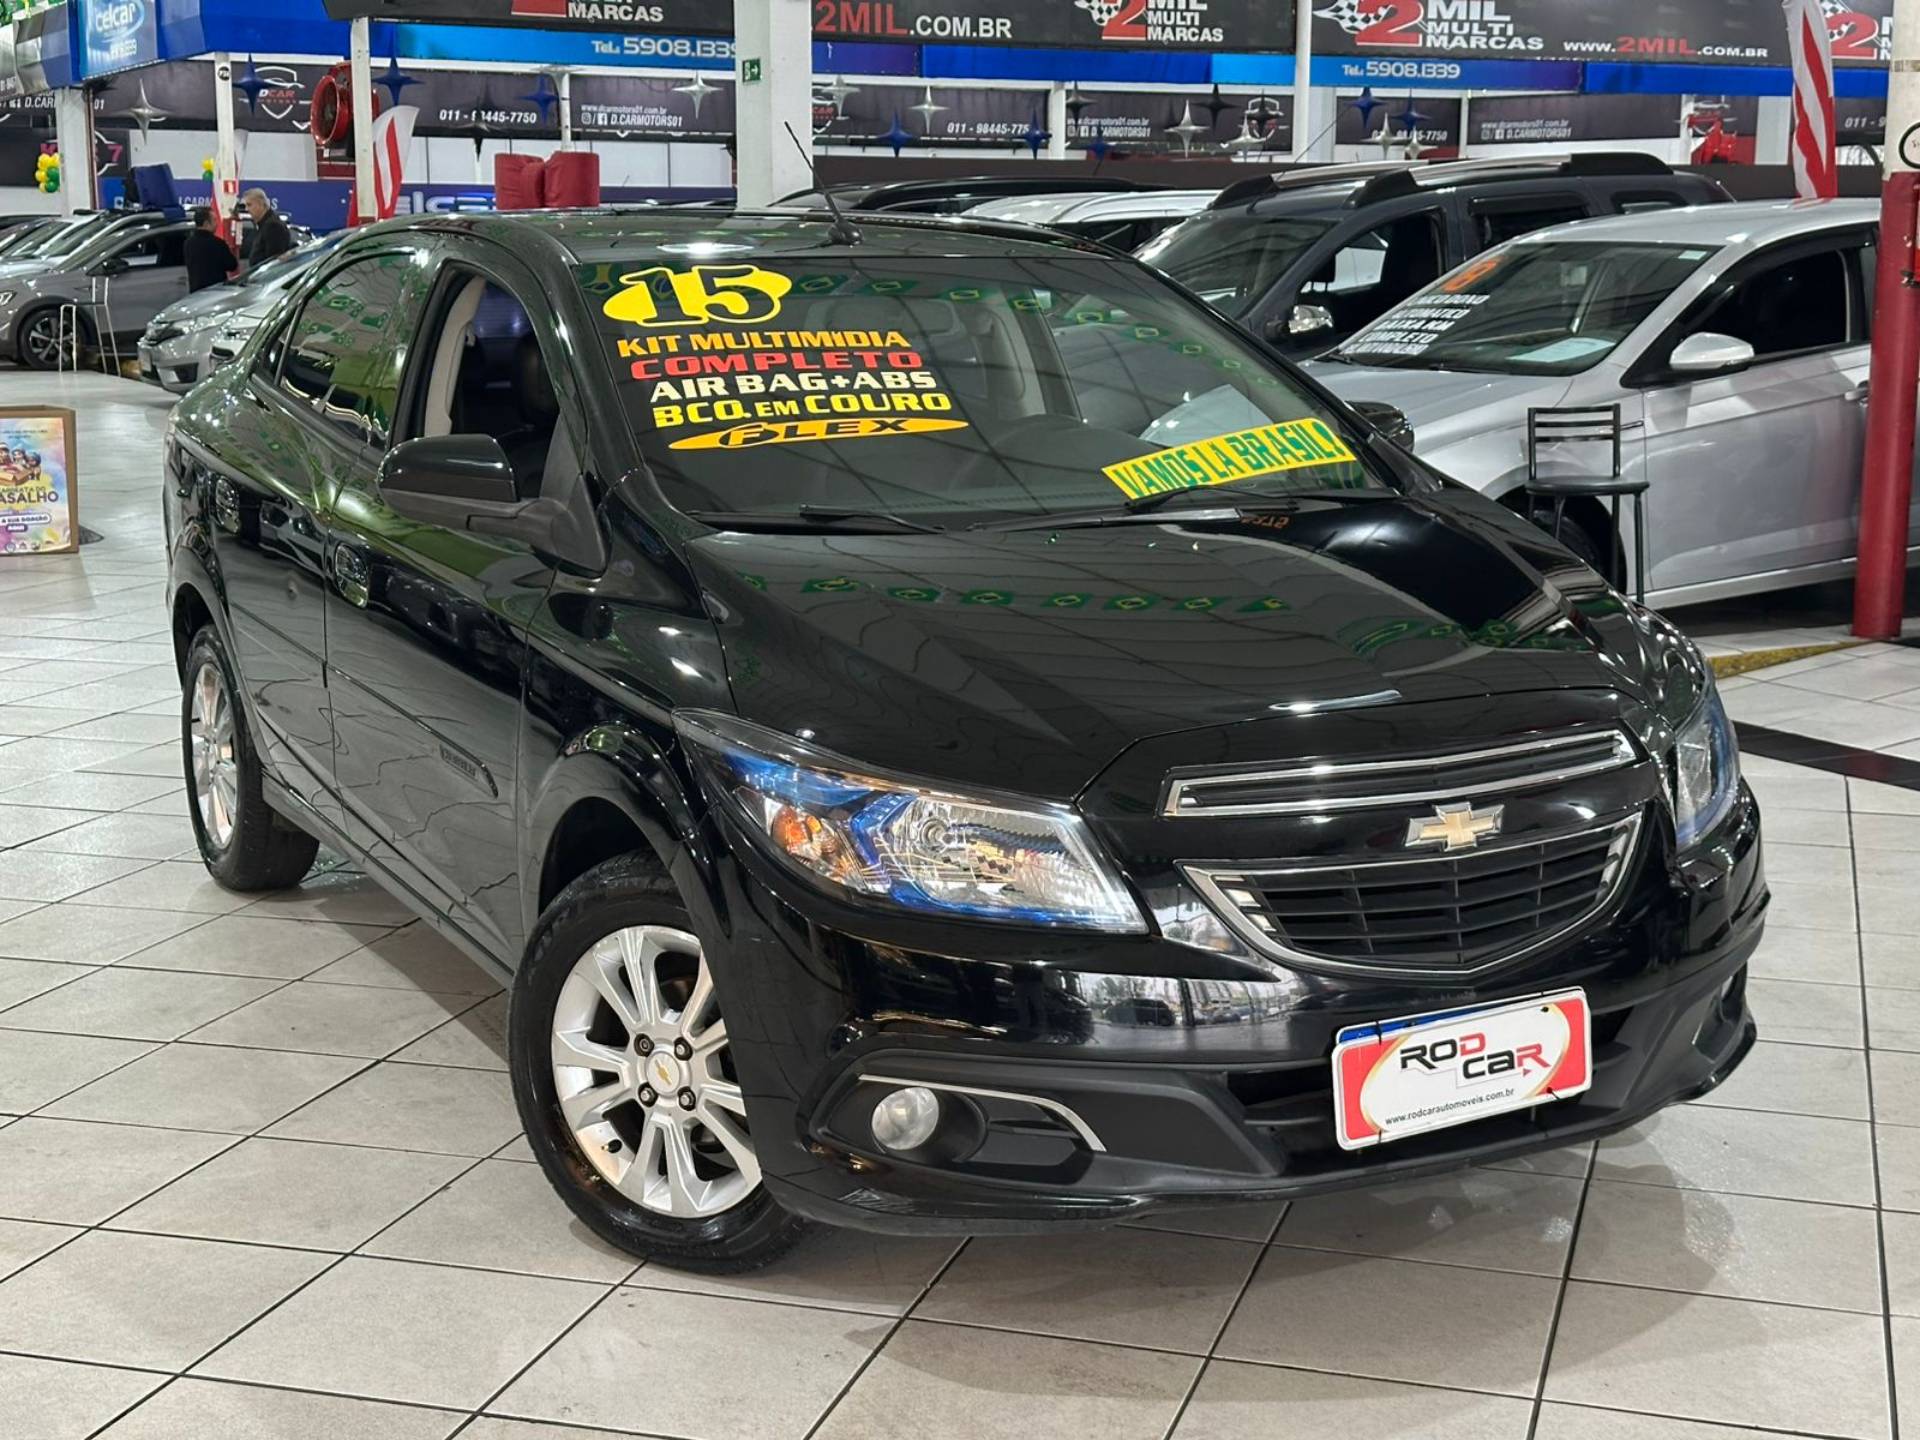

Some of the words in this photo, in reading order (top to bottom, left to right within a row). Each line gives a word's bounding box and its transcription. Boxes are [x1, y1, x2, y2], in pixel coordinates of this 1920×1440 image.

[567, 2, 665, 22] MARCAS
[1147, 10, 1200, 26] MULTI
[1427, 0, 1512, 22] MIL
[1147, 26, 1225, 42] MARCAS
[1426, 21, 1515, 36] MULTI
[1425, 34, 1545, 51] MARCAS
[1366, 60, 1461, 79] 5908.1339
[439, 109, 460, 120] 011
[610, 113, 683, 127] D.CARMOTORS01
[946, 122, 966, 134] 011
[976, 123, 1030, 135] 98445-775
[619, 265, 782, 327] 15
[617, 335, 681, 358] KIT
[630, 351, 923, 380] COMPLETO
[650, 376, 731, 403] AIR
[735, 371, 937, 394] BAG+ABS
[652, 399, 752, 429] BCO.
[754, 400, 800, 417] EM
[803, 393, 952, 414] COURO
[727, 419, 908, 447] FLEX
[1112, 448, 1212, 497] VAMOS
[1399, 1032, 1487, 1071] ROD
[1384, 1087, 1516, 1126] www.rodcarautomoveis.com.br
